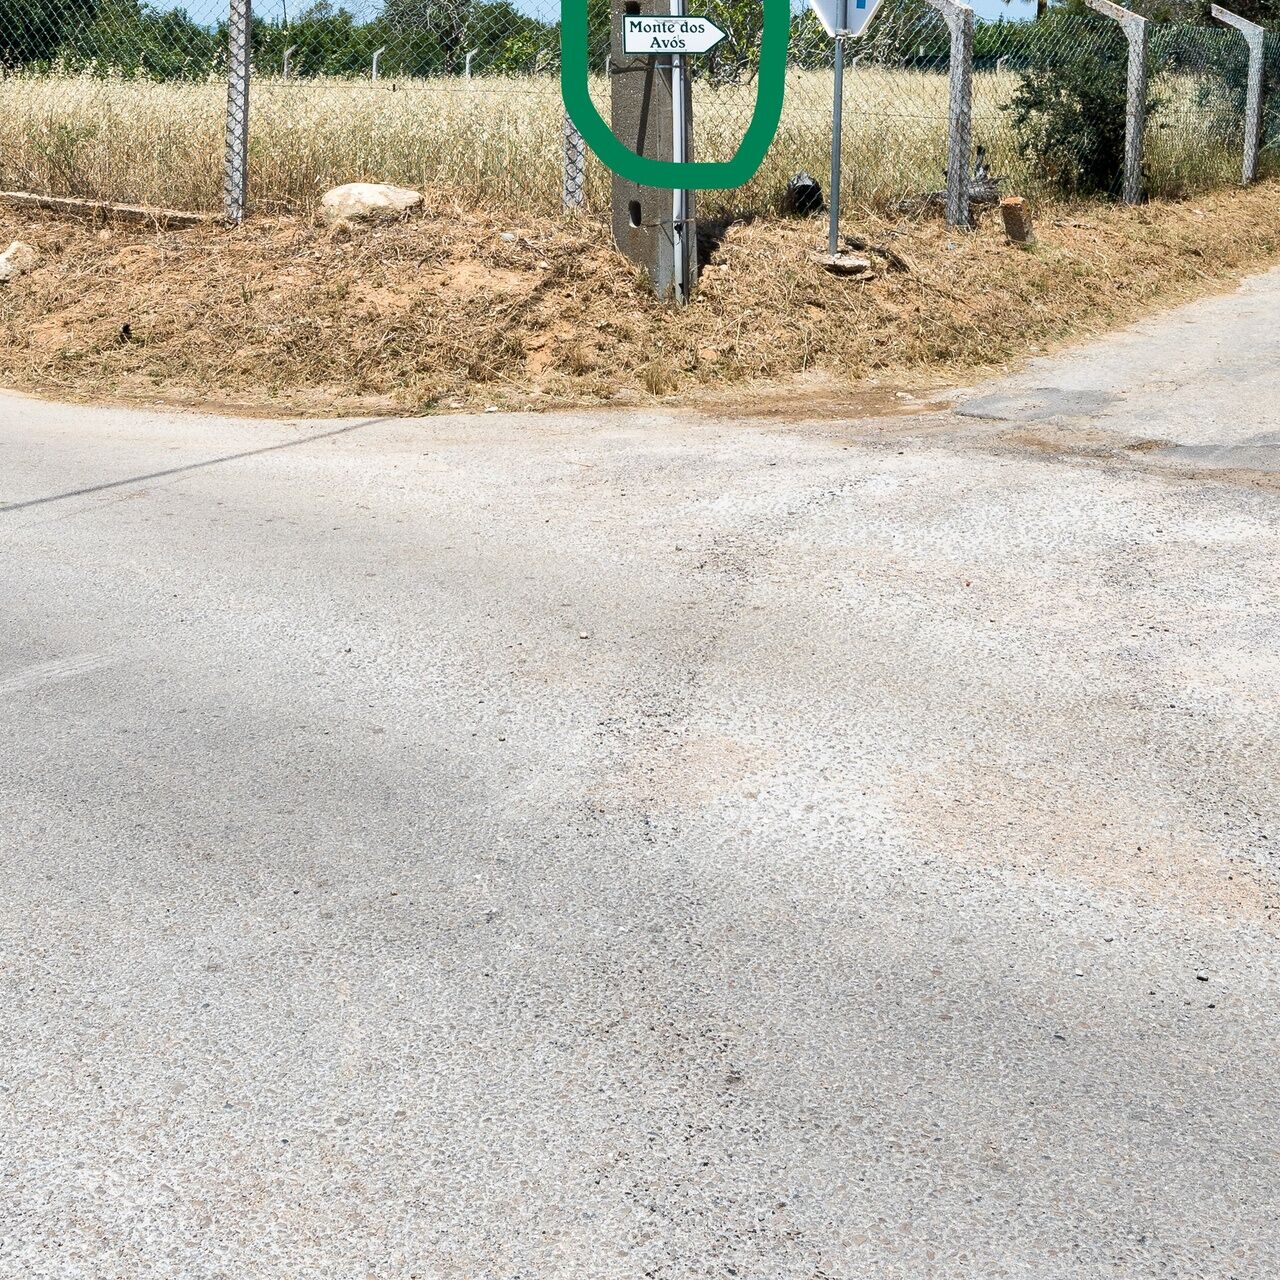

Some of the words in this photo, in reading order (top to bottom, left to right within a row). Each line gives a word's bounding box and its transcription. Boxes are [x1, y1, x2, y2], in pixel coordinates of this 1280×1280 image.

[629, 20, 676, 33] Monte
[680, 20, 705, 33] dos
[649, 36, 686, 48] Avós
